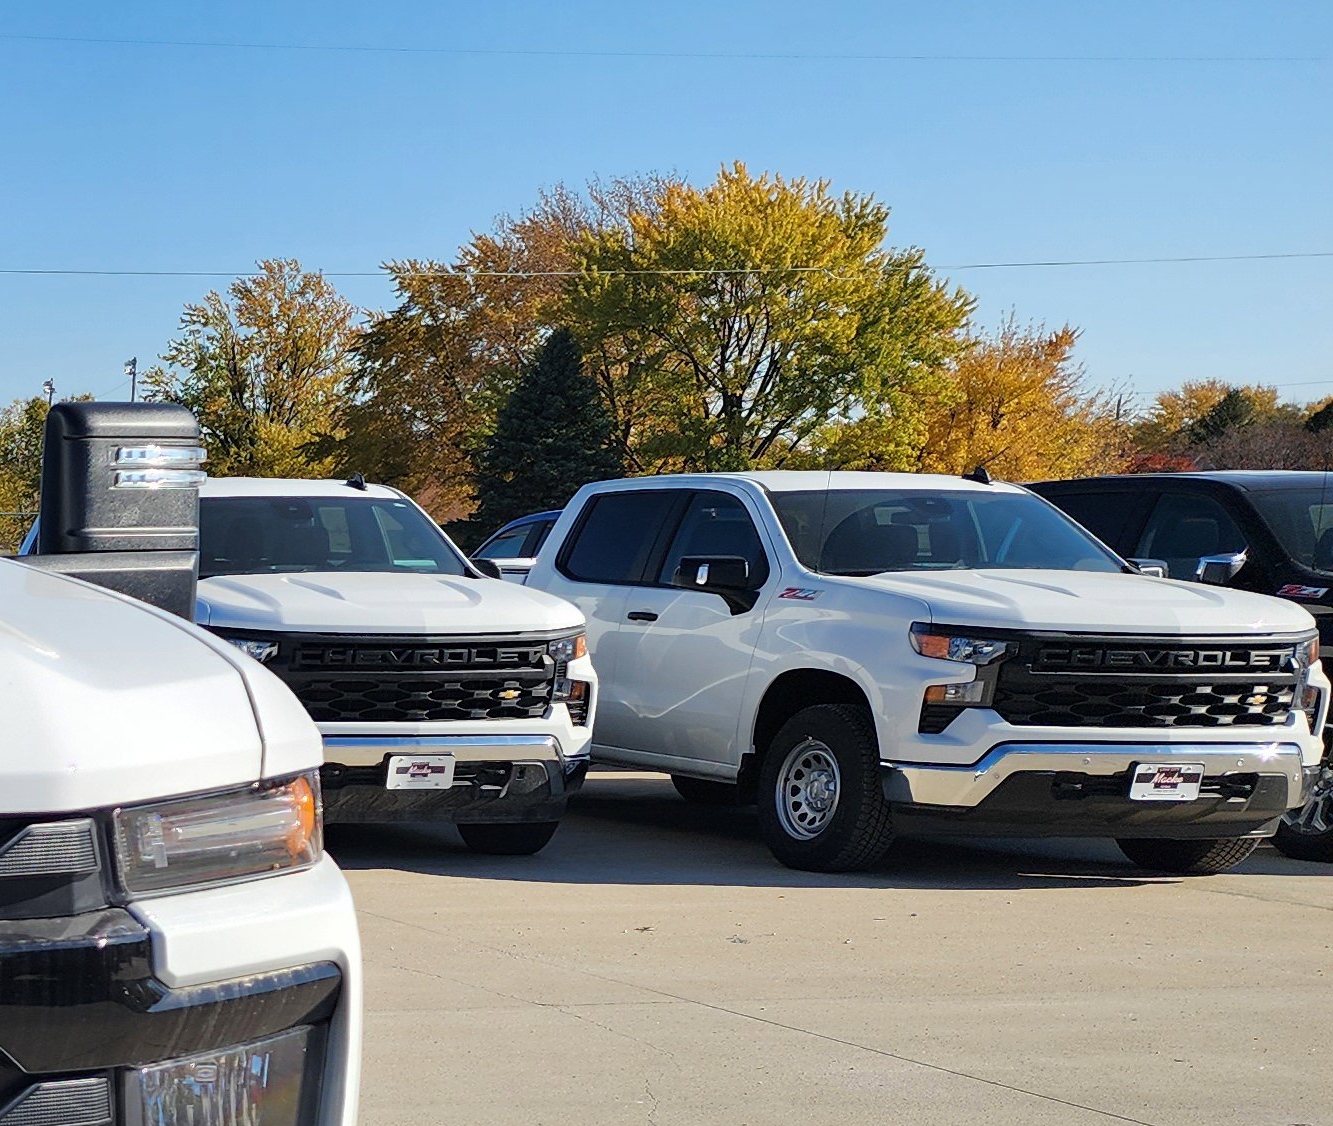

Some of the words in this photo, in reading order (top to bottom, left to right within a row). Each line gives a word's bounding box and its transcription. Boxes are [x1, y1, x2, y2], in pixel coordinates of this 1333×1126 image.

[295, 646, 546, 666] CHEVROLET
[1040, 648, 1294, 667] CHEVROLET
[1150, 772, 1184, 784] Macke
